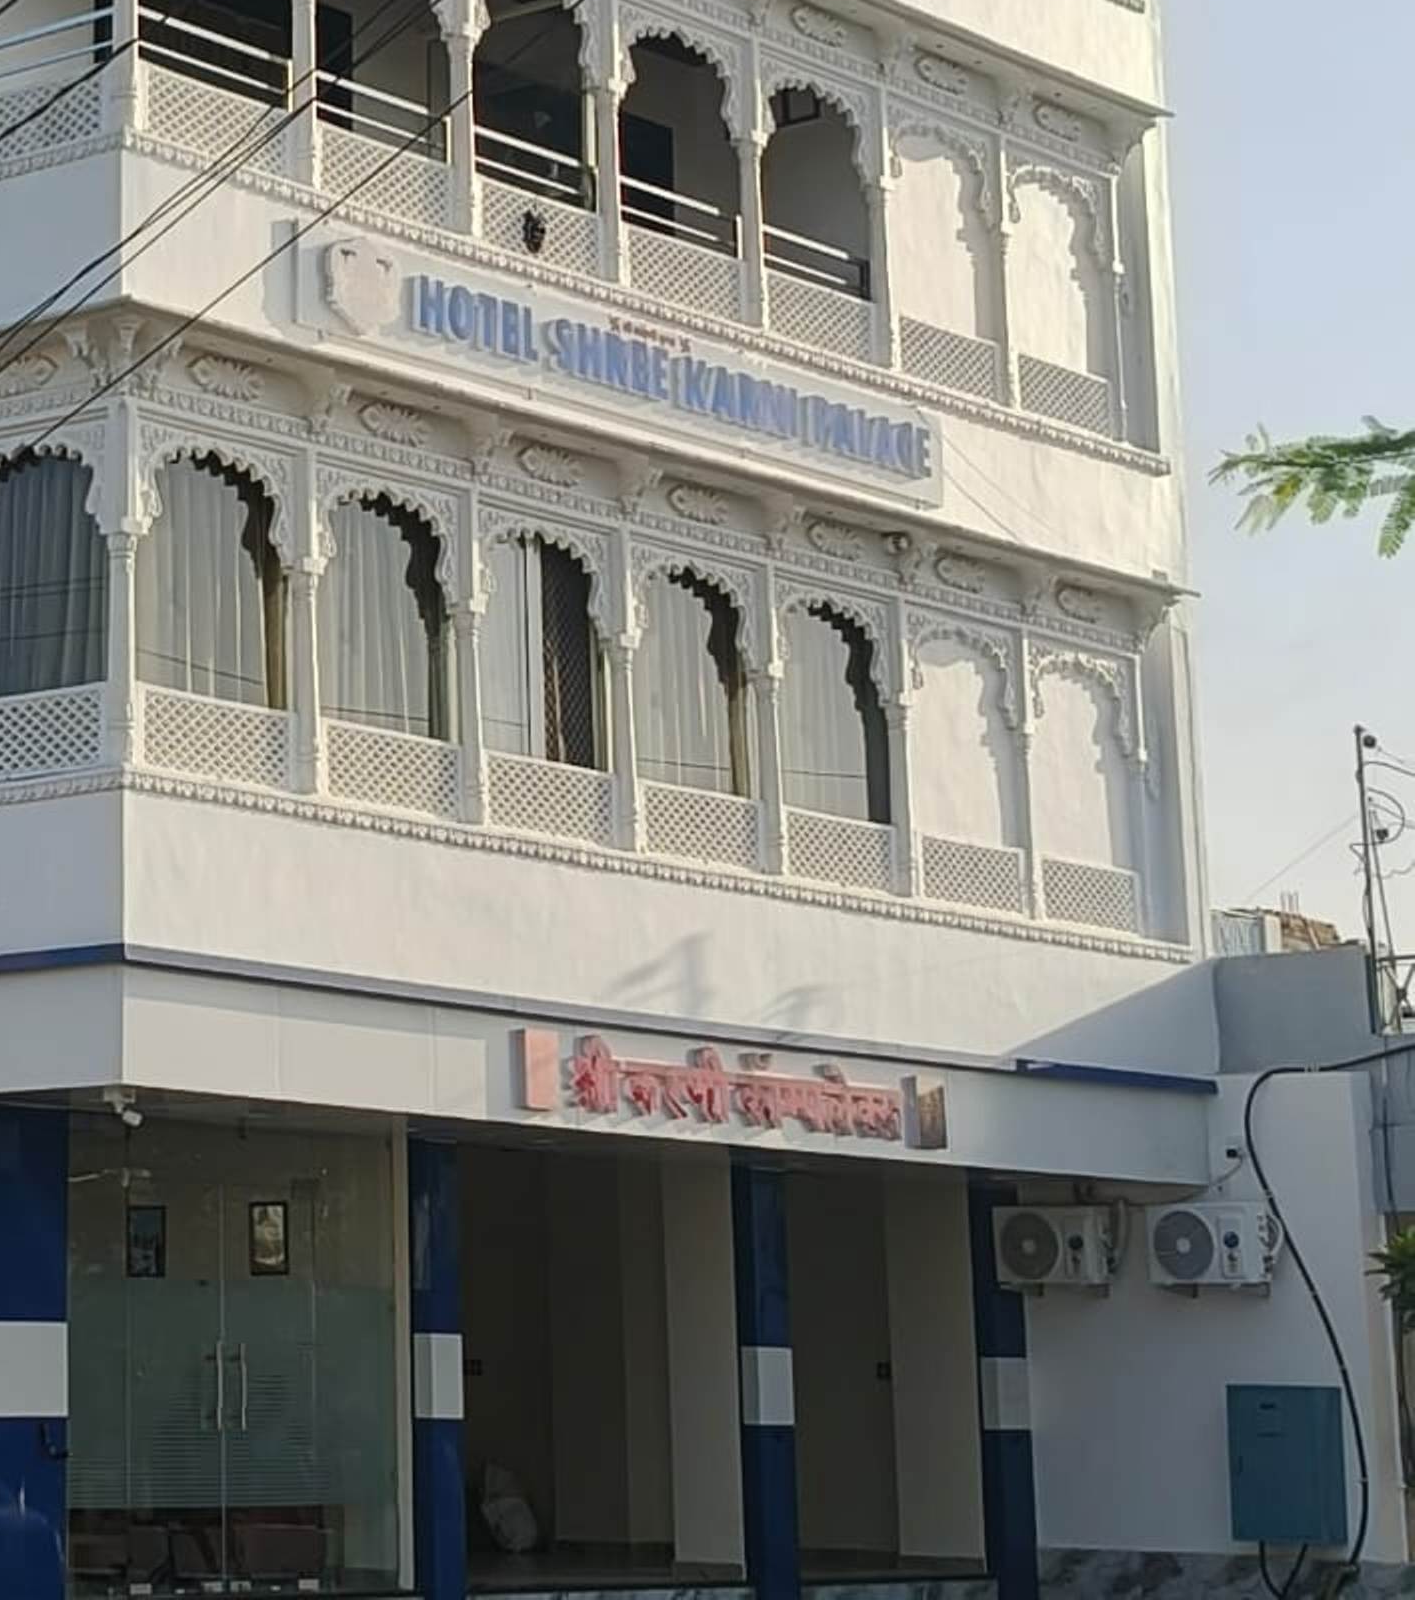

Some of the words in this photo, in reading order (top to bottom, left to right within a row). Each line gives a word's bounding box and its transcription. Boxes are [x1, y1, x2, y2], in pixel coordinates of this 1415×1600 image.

[411, 273, 538, 364] HOTEL
[547, 317, 670, 402] SHREE
[800, 394, 933, 480] PALACE
[571, 1033, 618, 1114] श्री
